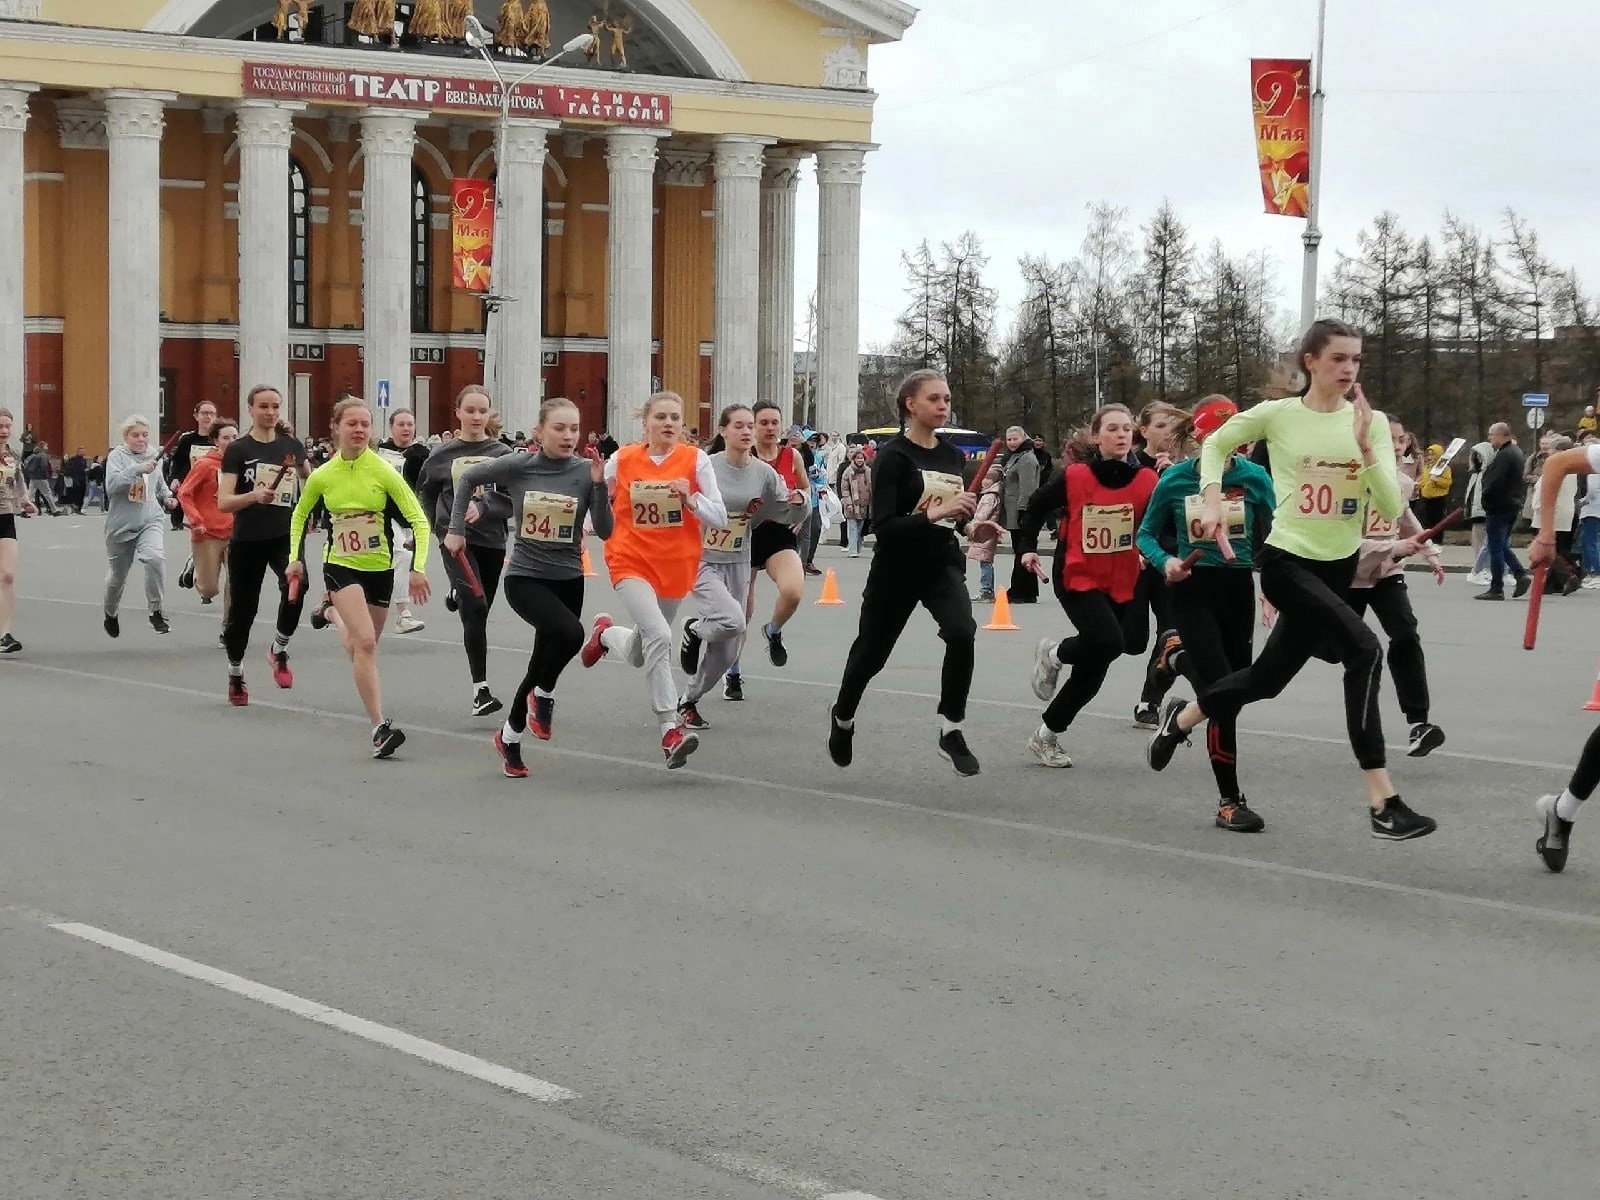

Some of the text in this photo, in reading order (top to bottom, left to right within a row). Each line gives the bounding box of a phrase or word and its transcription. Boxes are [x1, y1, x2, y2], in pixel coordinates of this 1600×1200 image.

[252, 66, 346, 84] ГОСУДАРСТВЕННЫЙ
[252, 78, 346, 95] АКАДЕМИЧЕСКИЙ
[348, 73, 440, 102] ТЕАТР
[1255, 70, 1298, 118] 9
[568, 102, 663, 121] ГАСТРОЛИ
[612, 93, 659, 108] МАЯ
[1260, 123, 1307, 142] Мая
[455, 187, 486, 220] 9
[457, 223, 490, 239] Мая
[1299, 483, 1332, 514] 30
[633, 502, 660, 525] 28
[525, 512, 551, 538] 34
[337, 530, 361, 552] 18
[706, 528, 732, 547] 37
[1086, 527, 1112, 549] 50
